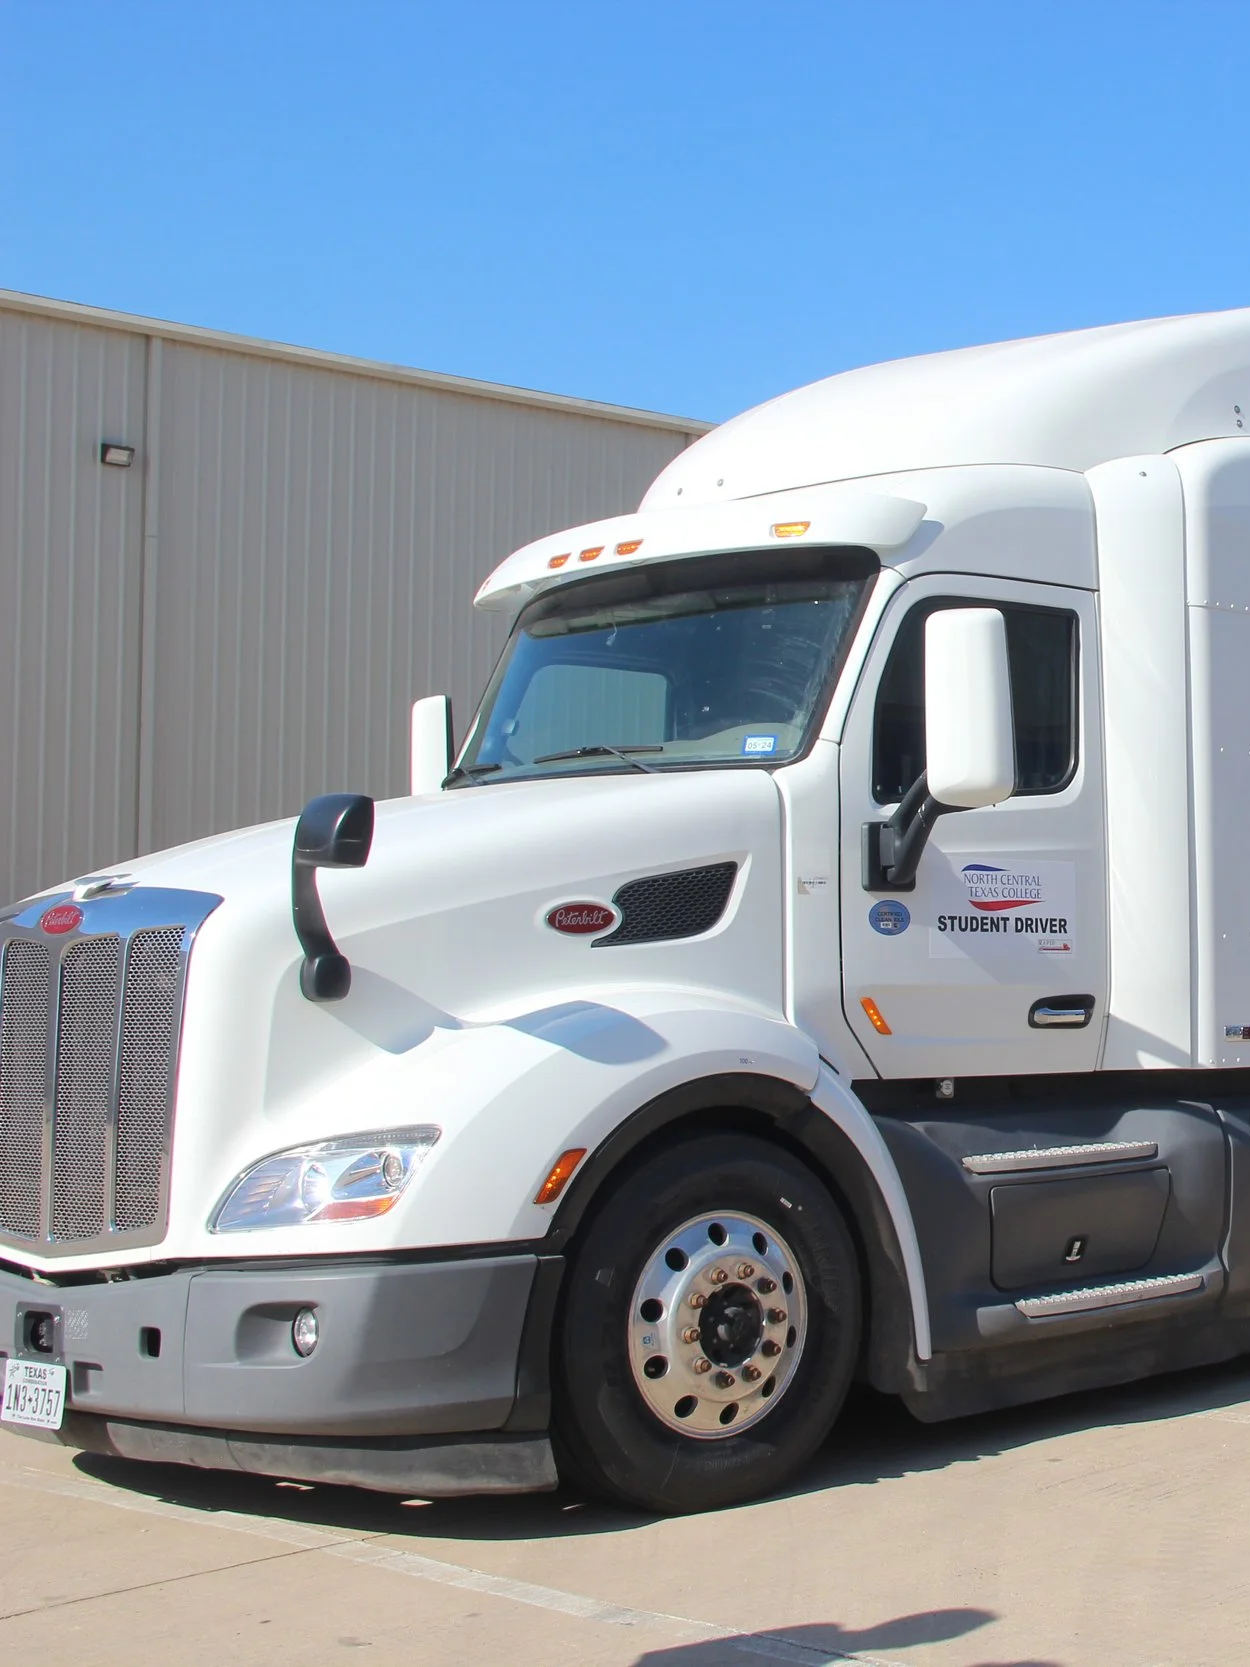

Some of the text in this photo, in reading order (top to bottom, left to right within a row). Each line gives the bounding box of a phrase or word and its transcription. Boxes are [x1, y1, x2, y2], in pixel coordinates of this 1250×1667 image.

[963, 872, 1042, 887] NORTH CENTRAL
[968, 886, 1042, 899] TEXAS COLLEGE
[555, 909, 608, 927] Peterbilt
[937, 915, 1068, 934] STUDENT DRIVER
[24, 1366, 47, 1380] TEXAS
